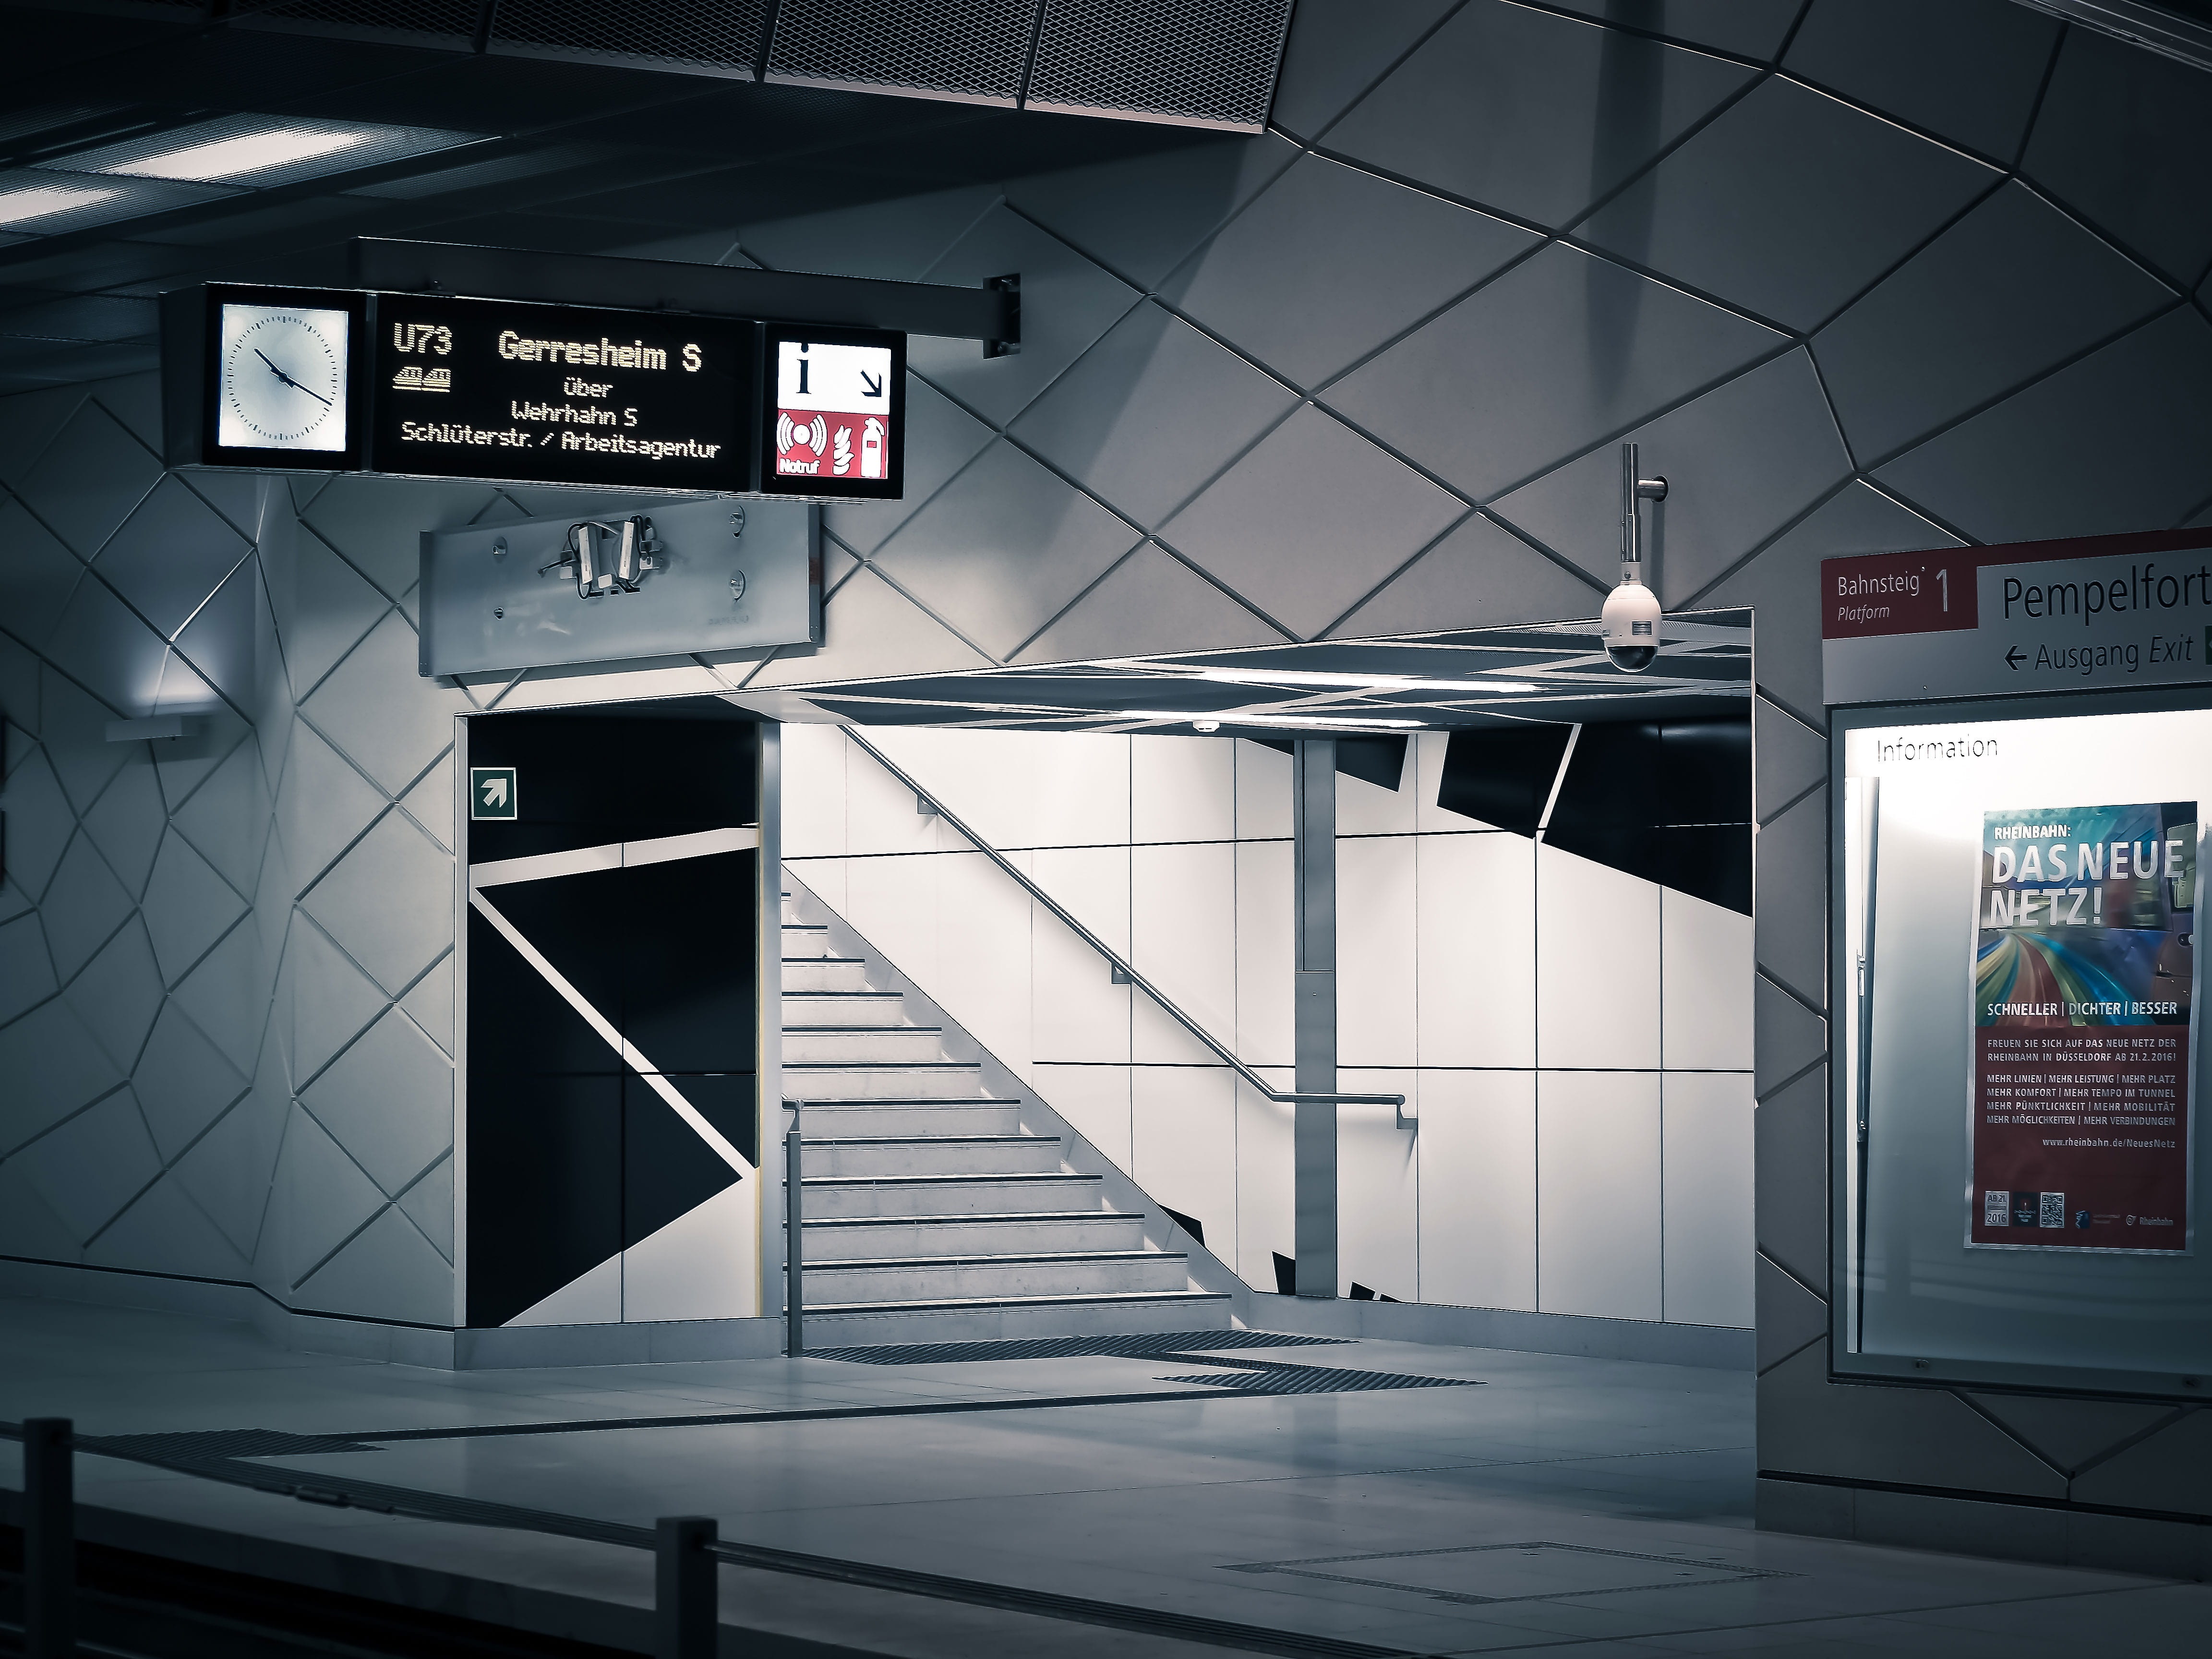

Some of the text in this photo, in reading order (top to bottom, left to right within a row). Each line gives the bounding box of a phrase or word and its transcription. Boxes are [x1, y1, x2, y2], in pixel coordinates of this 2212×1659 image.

[394, 323, 452, 355] U73
[498, 330, 701, 372] Gerresheim S
[564, 377, 613, 397] über
[512, 401, 637, 426] Wehrhahn S
[401, 421, 532, 447] Schlüterstr.
[561, 431, 721, 459] Arbeitsagentur
[779, 458, 821, 474] Notruf
[1838, 569, 1948, 612] Bahnsteig 1
[2003, 562, 2212, 627] Pempelfort
[1838, 605, 1890, 624] Platform
[2034, 635, 2194, 676] Ausgang Exit
[1877, 734, 1998, 763] Information
[1994, 825, 2071, 840] RHEINBAHN:
[1992, 840, 2184, 883] DAS NEUE
[1988, 887, 2102, 926] NETZ!
[1987, 1003, 2057, 1016] SCHNELLER
[2069, 1002, 2120, 1016] DICHTER
[2131, 1002, 2177, 1015] BESSER
[1987, 1039, 2176, 1047] FREUEN SIE SICH AUF DAS NEUE NETZ DER
[2056, 1051, 2111, 1061] DÜSSELDORF
[1987, 1075, 2011, 1083] MEHR
[2014, 1075, 2042, 1083] LINIEN
[2049, 1075, 2072, 1083] MEHR
[2075, 1075, 2114, 1083] LEISTUNG
[2122, 1075, 2145, 1083] MEHR
[2149, 1075, 2176, 1083] PLATZ
[1987, 1089, 2011, 1097] MEHR
[2016, 1089, 2056, 1097] KOMFORT
[2064, 1089, 2089, 1097] MEHR
[2092, 1089, 2122, 1097] TEMPO
[2125, 1089, 2135, 1097] IM
[2139, 1089, 2175, 1097] TUNNEL
[2016, 1101, 2085, 1110] PÜNKTLICHKEIT
[2094, 1103, 2120, 1111] MEHR
[2124, 1102, 2176, 1111] MOBILITÄT
[2012, 1114, 2075, 1124] MÖGLICHKEITEN
[2084, 1117, 2107, 1125] MEHR
[2110, 1117, 2176, 1126] VERBINDUNGEN
[2043, 1138, 2176, 1148] www.rheinbahn.de/NeuesNetz
[1987, 1214, 2006, 1223] 2016
